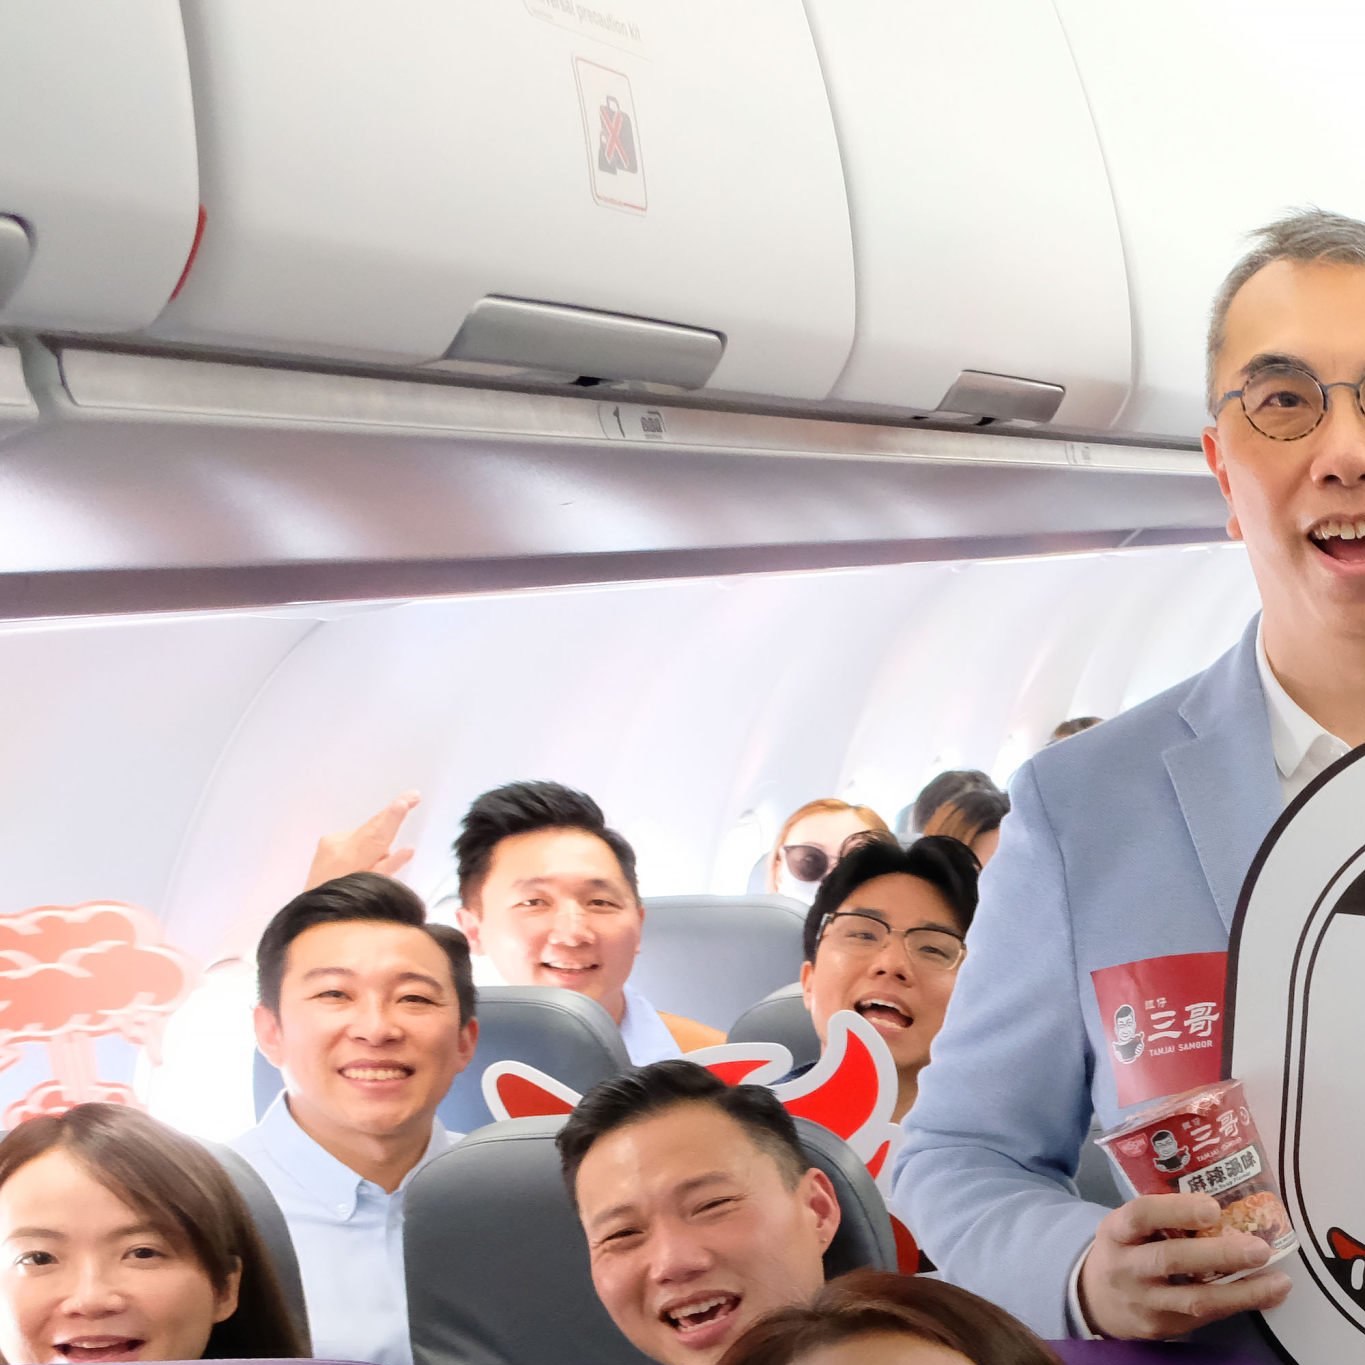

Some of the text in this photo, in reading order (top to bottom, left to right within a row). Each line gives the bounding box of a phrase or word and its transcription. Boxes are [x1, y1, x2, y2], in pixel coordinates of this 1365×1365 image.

[1147, 1002, 1220, 1041] 三哥
[1149, 1045, 1175, 1056] TAMJAI
[1191, 1111, 1239, 1153] 三哥
